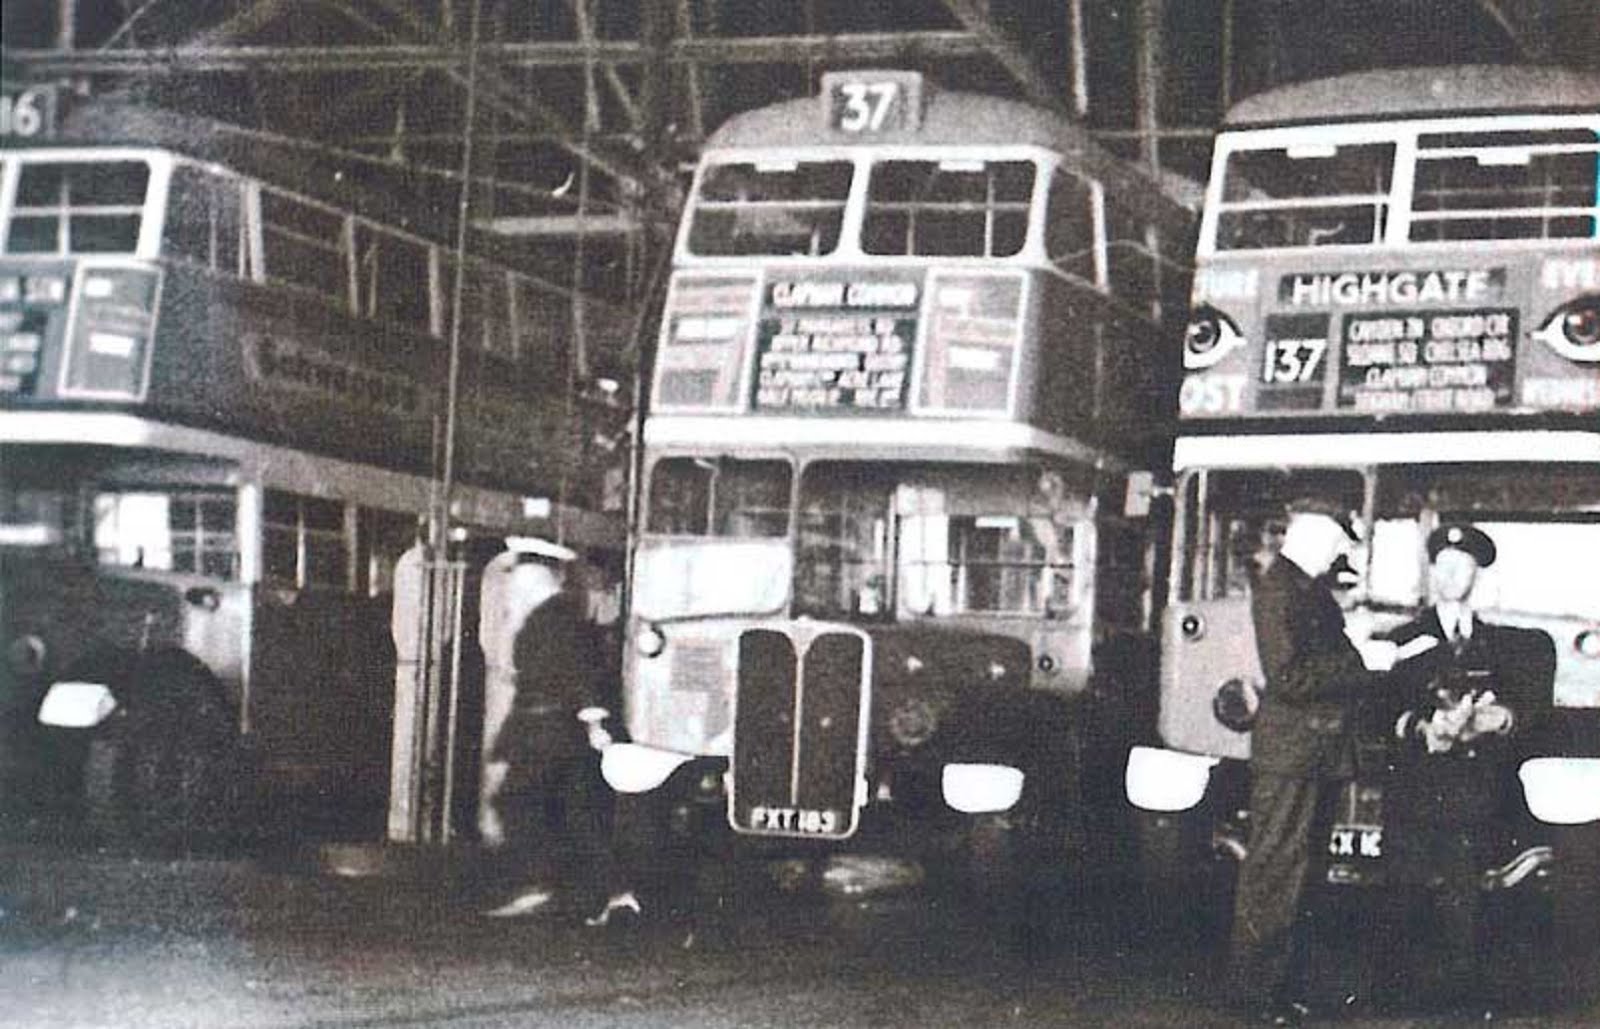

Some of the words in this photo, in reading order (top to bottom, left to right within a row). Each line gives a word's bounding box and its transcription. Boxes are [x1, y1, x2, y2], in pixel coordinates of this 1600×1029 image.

[841, 82, 898, 130] 37
[1292, 270, 1489, 305] HIGHGATE
[1263, 337, 1327, 383] 137
